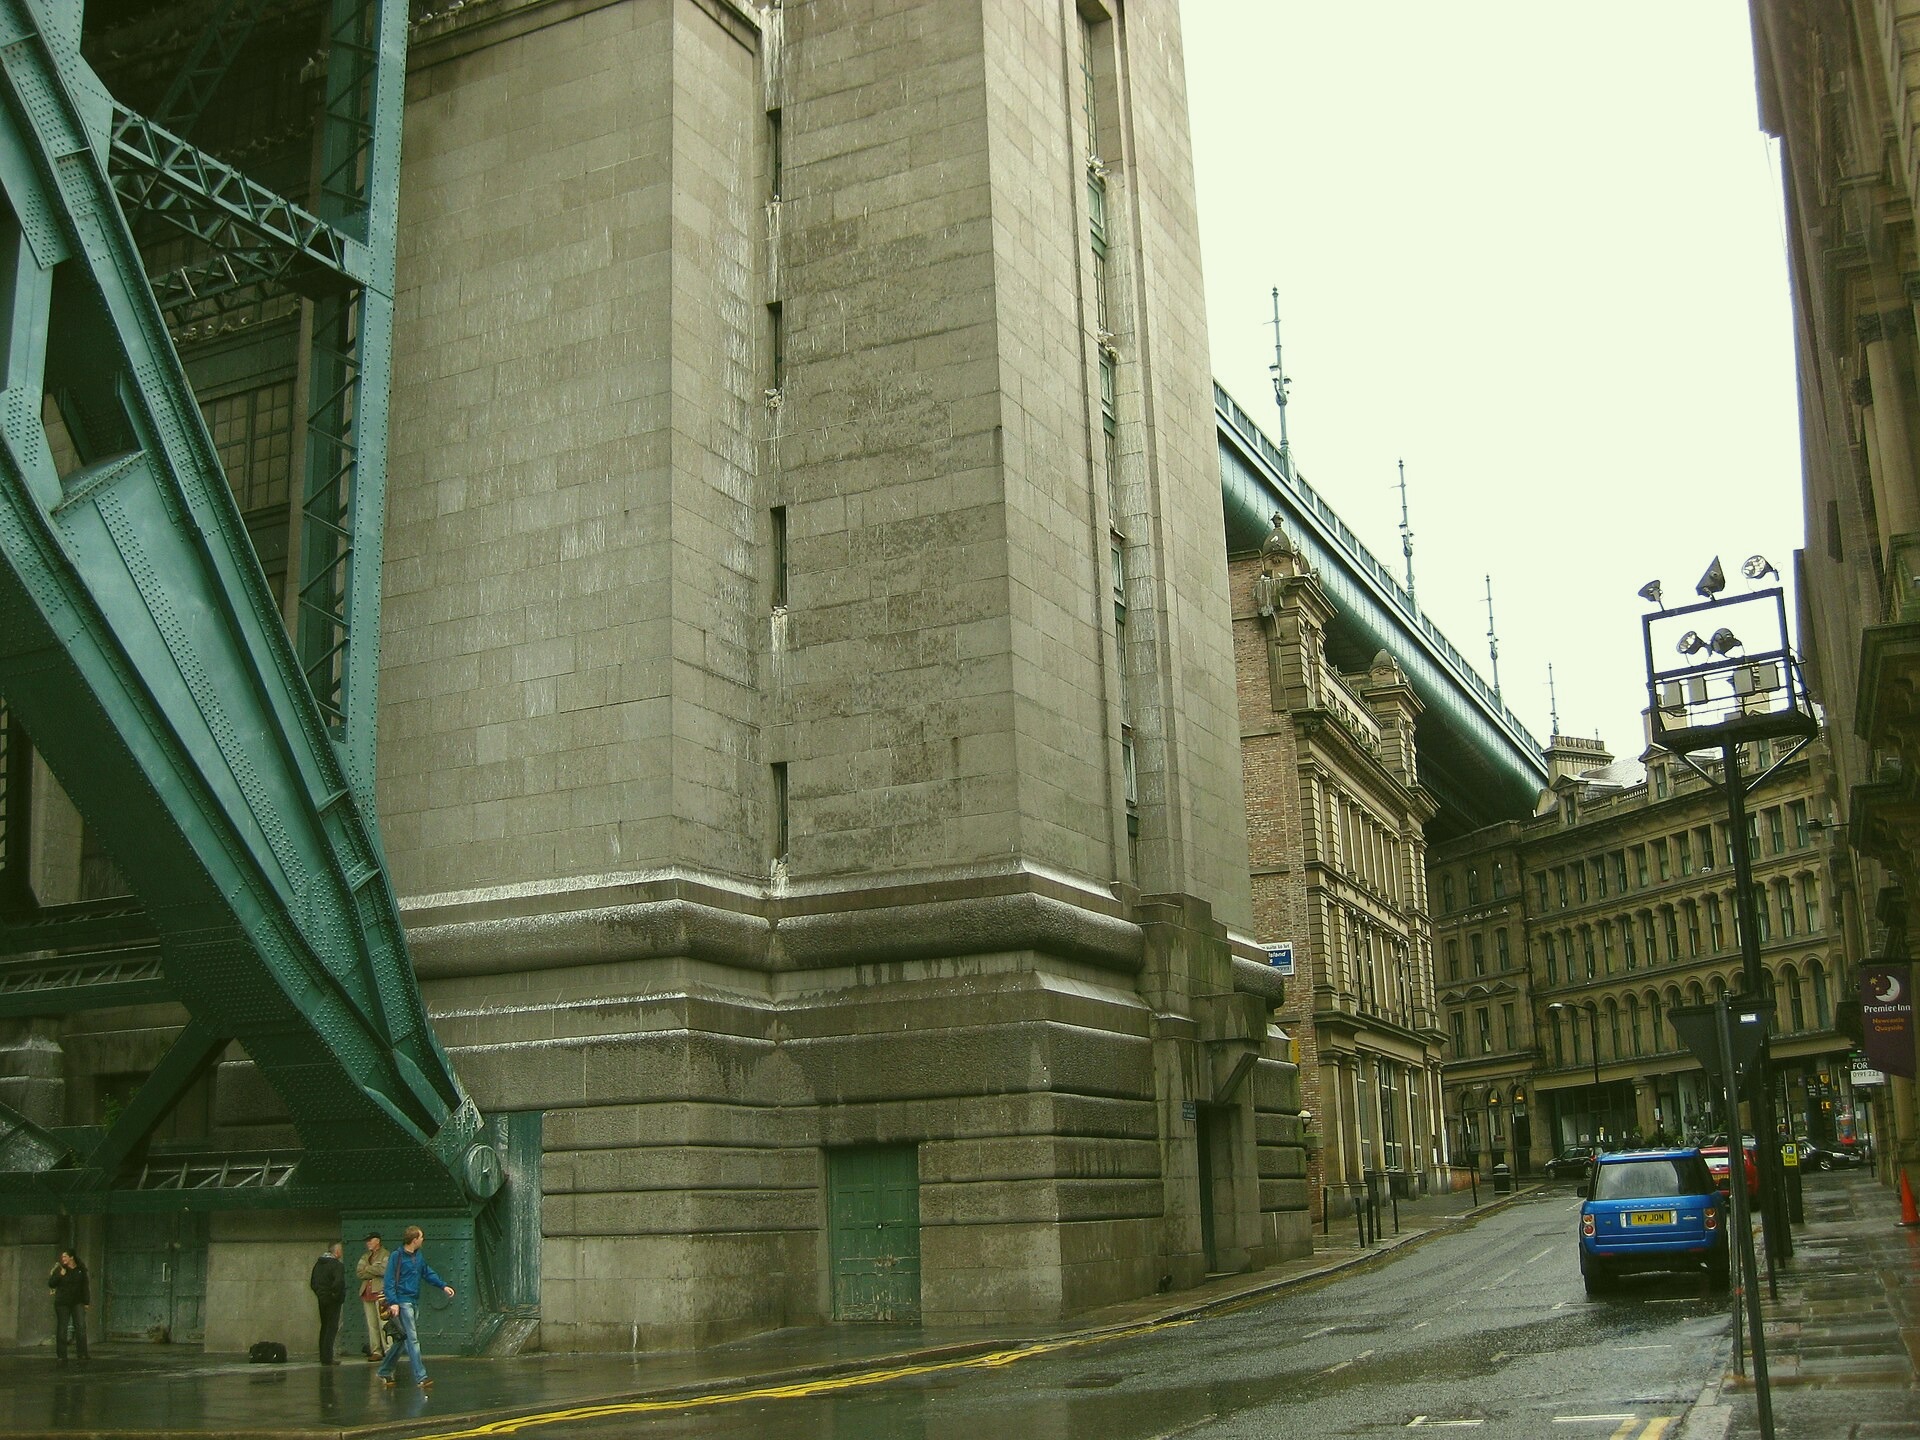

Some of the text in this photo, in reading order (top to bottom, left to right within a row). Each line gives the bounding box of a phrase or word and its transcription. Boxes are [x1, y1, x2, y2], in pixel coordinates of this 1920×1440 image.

[1863, 1003, 1911, 1013] Premier Inn
[1852, 1061, 1868, 1070] FOR
[1637, 1214, 1647, 1222] K7
